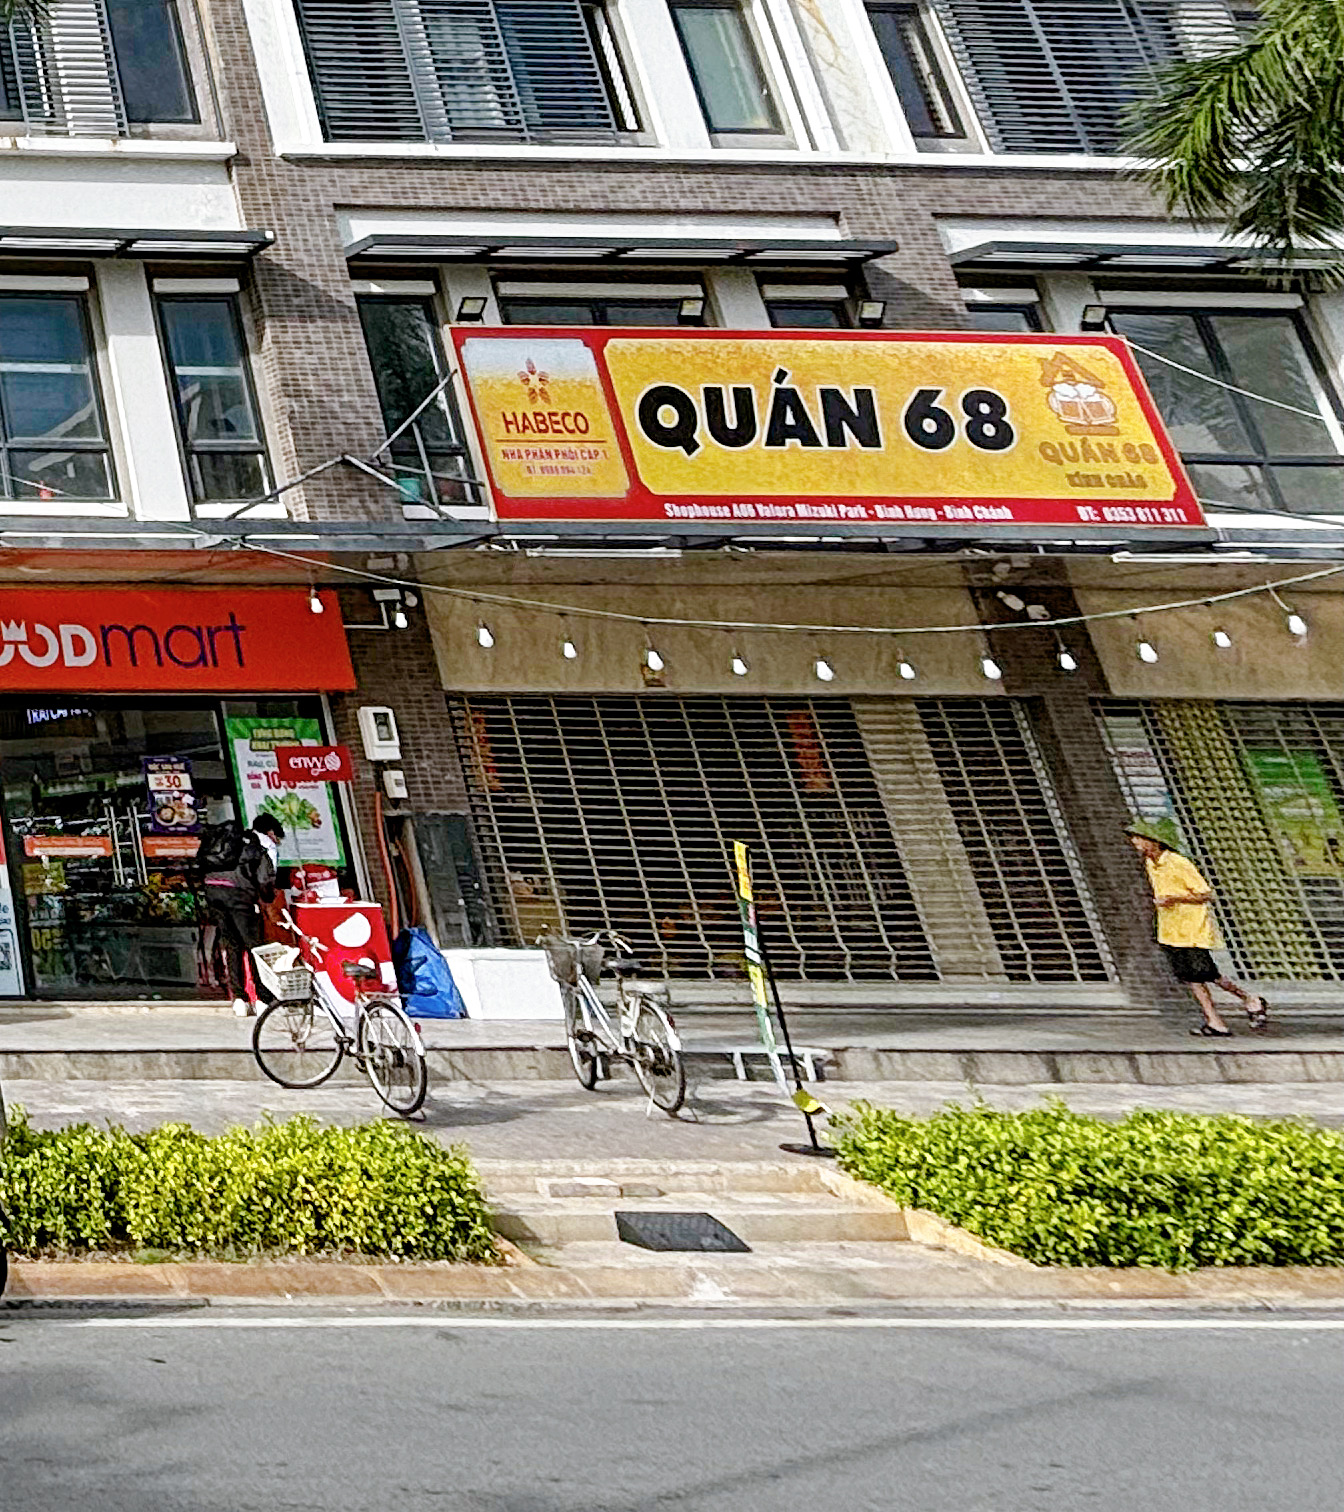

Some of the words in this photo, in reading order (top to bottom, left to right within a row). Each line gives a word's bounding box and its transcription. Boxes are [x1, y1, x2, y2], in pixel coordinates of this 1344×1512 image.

[501, 410, 590, 435] HABECO
[638, 366, 882, 458] QUÁN
[904, 387, 1016, 452] 68
[1039, 436, 1120, 466] QUÁN
[288, 755, 327, 776] envy
